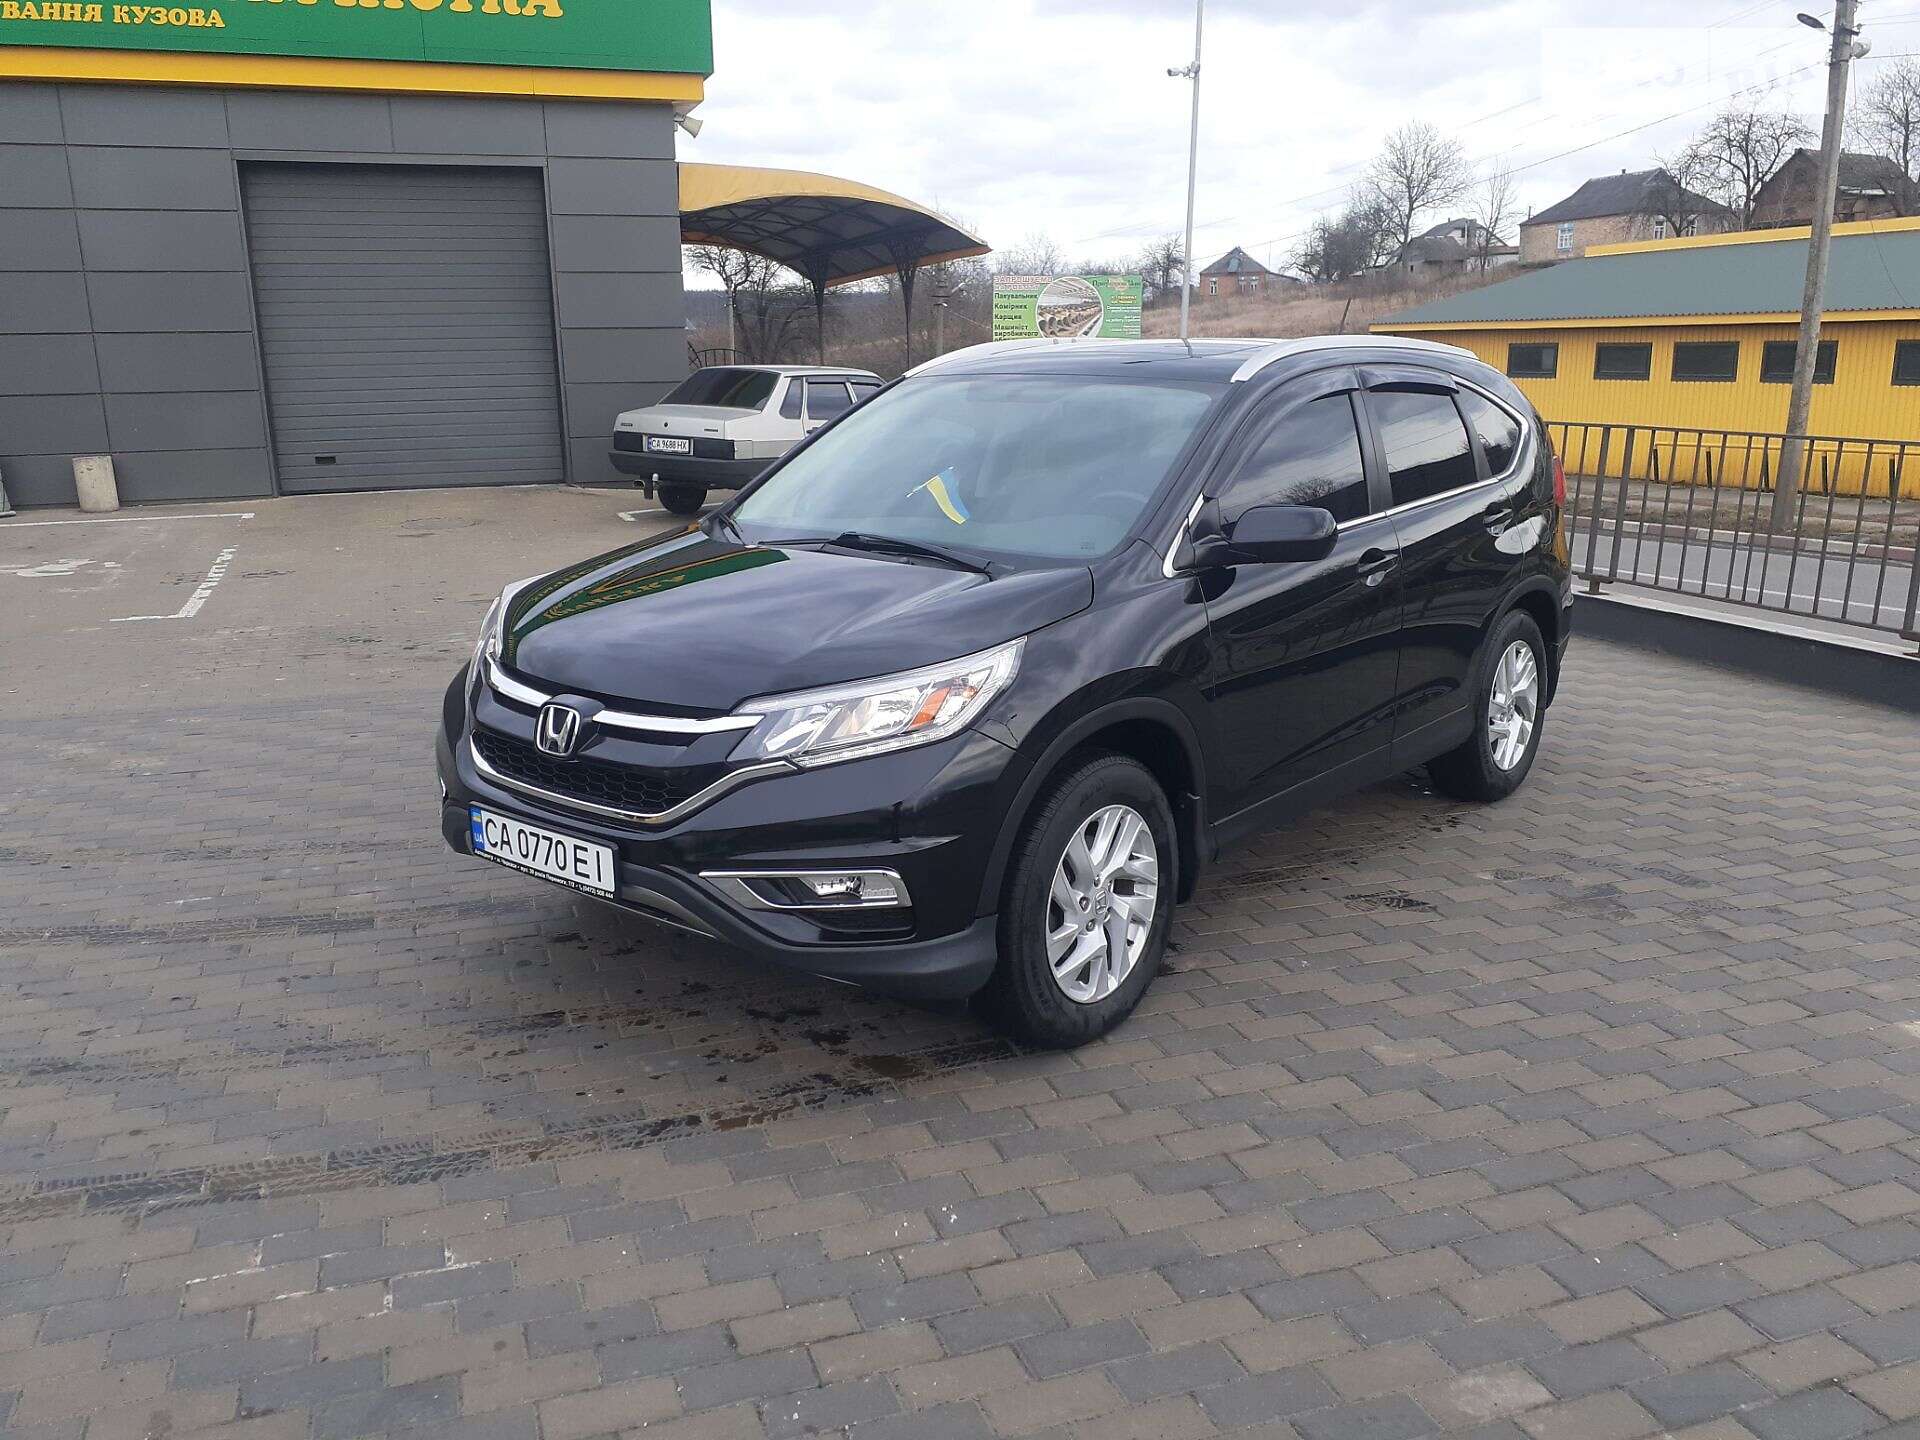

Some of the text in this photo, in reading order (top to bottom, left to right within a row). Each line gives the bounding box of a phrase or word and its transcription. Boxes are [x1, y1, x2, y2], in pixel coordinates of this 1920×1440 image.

[0, 1, 103, 23] ВАННЯ
[112, 5, 226, 28] КУЗОВА
[994, 302, 1028, 311] Комірник
[474, 831, 484, 843] UA
[485, 818, 513, 855] CA
[517, 828, 567, 871] 0770
[574, 844, 602, 883] EI
